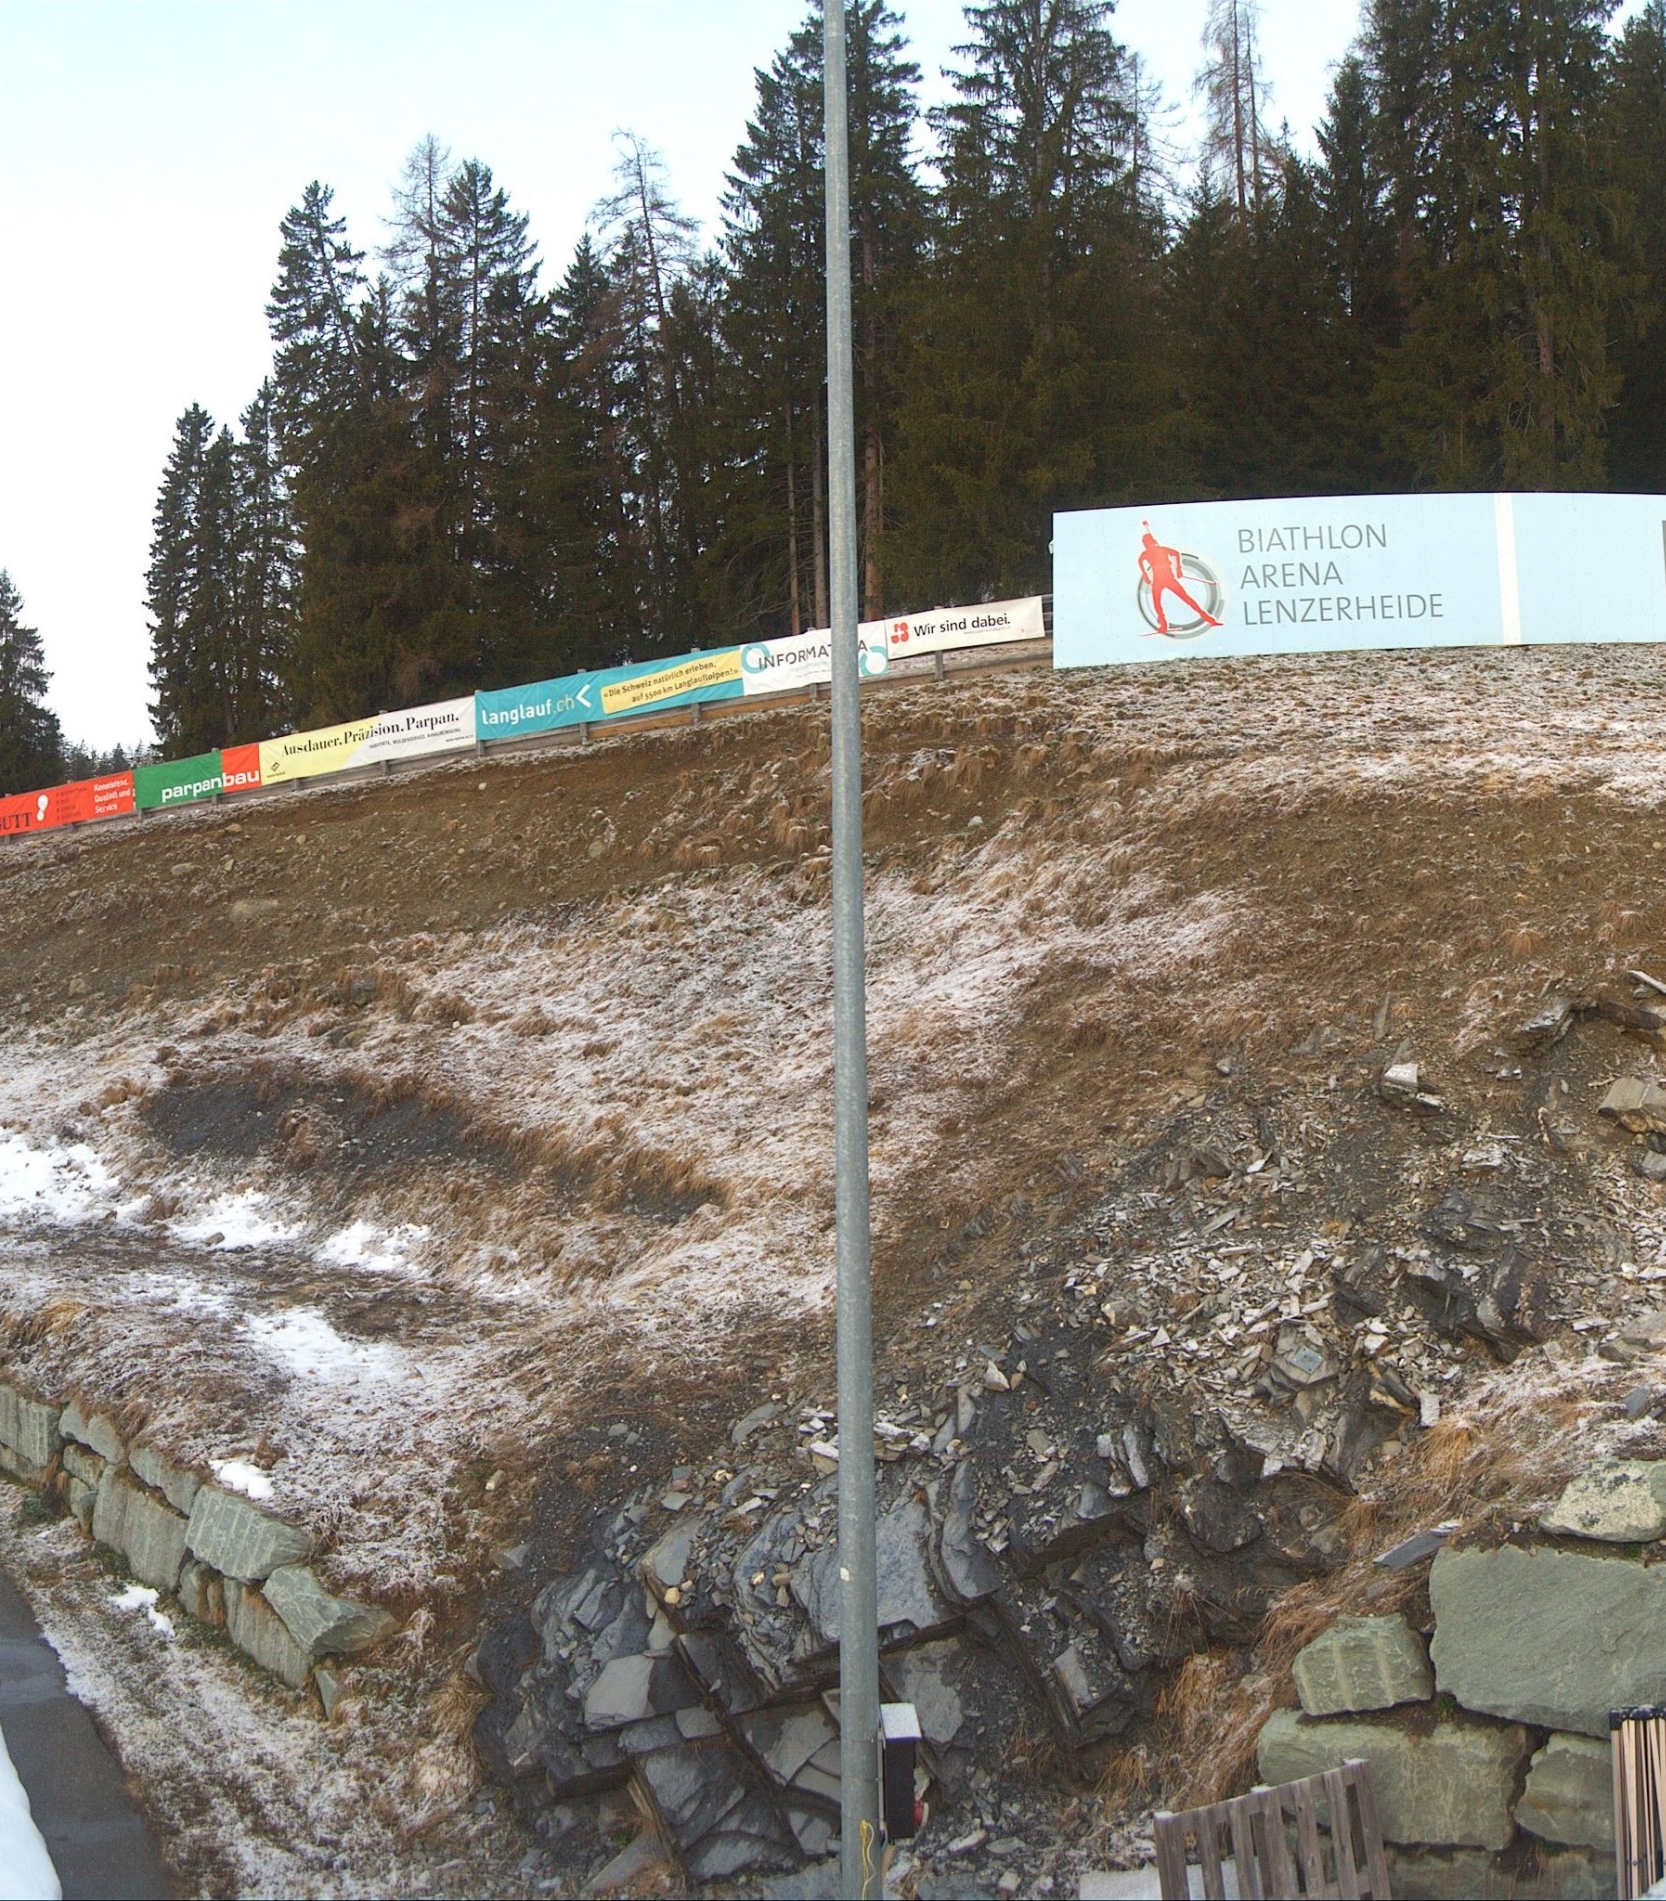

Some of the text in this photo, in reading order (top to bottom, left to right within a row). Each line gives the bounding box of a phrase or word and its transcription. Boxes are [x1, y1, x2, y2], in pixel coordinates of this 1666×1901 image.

[1238, 523, 1387, 553] BIATHLON
[1240, 560, 1343, 589] ARENA
[1243, 592, 1444, 626] LENZERHEIDE
[913, 624, 936, 637] Wir
[940, 618, 967, 633] sind
[971, 613, 1011, 628] dabei.
[622, 679, 652, 694] Schweiz
[662, 686, 674, 695] km
[482, 694, 575, 726] langlauf.ch
[284, 712, 460, 756] Ausdauer. Präzision. Parpan.
[119, 789, 131, 798] und
[161, 770, 259, 803] parpanbau
[94, 803, 118, 814] Service
